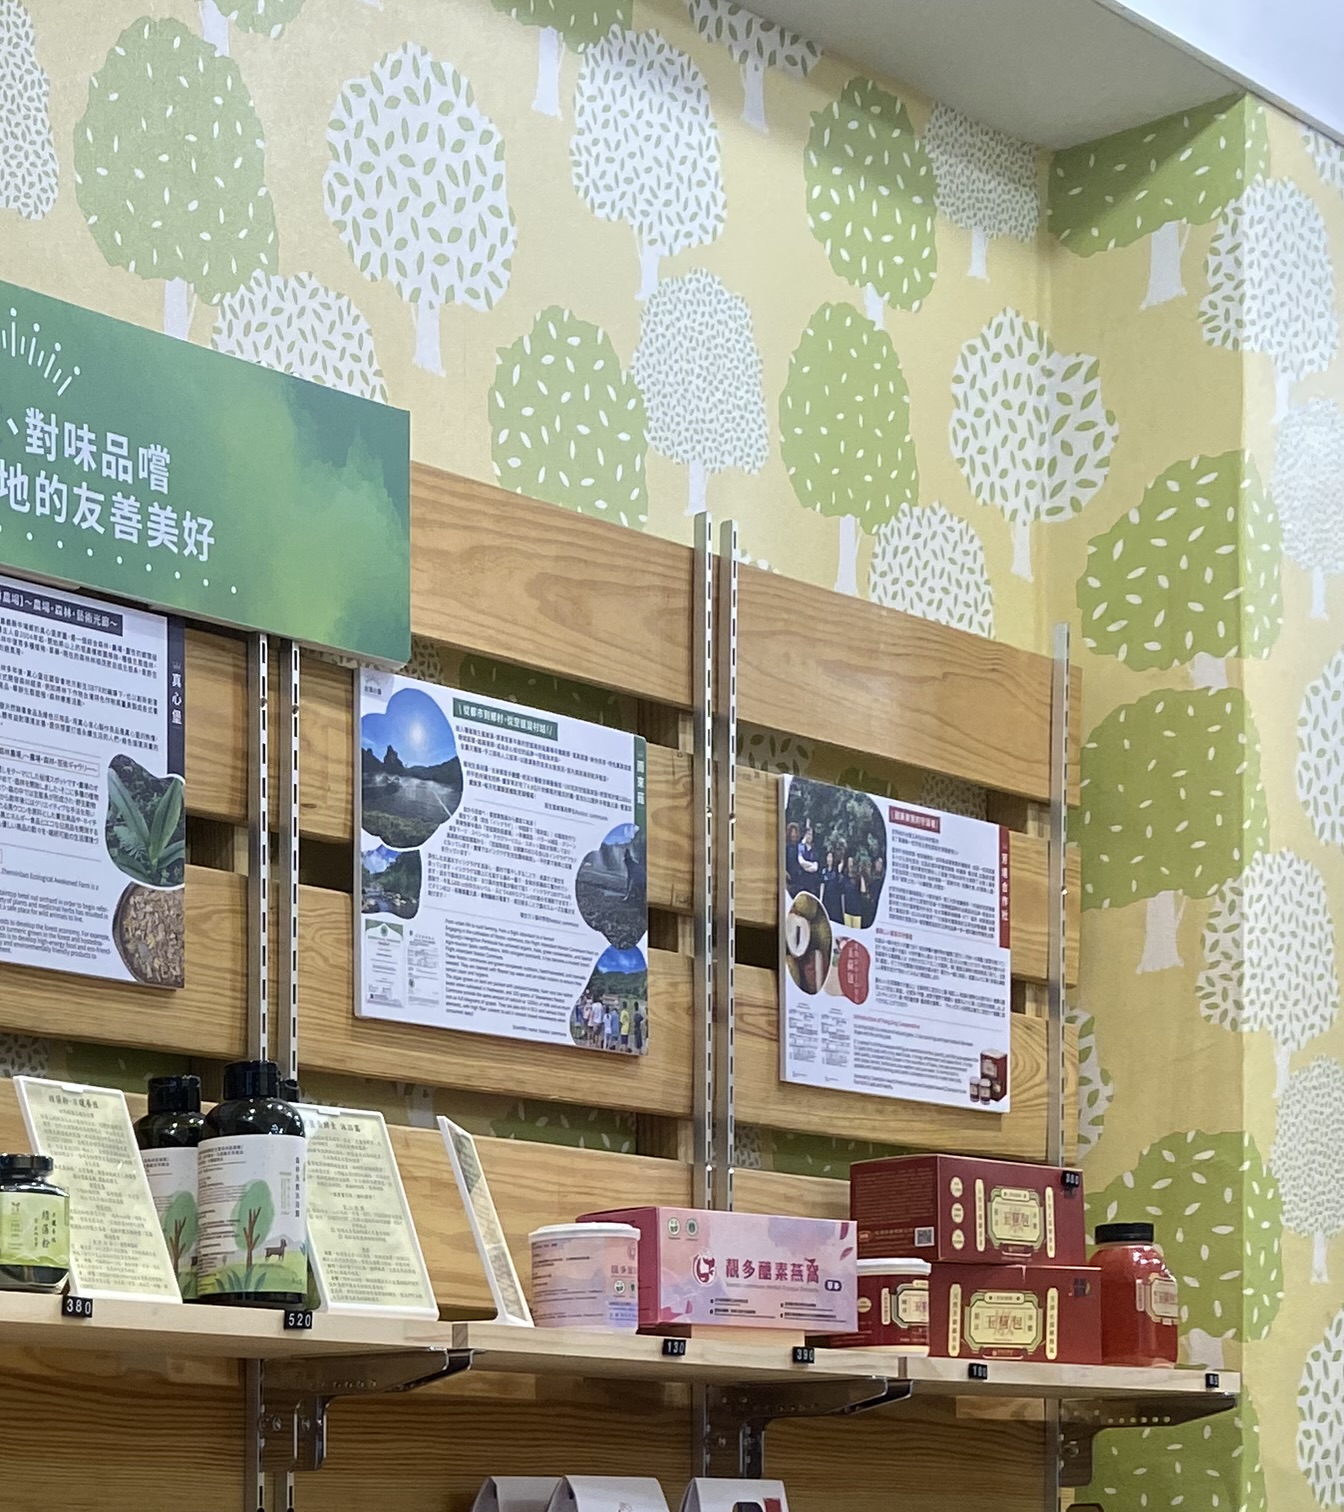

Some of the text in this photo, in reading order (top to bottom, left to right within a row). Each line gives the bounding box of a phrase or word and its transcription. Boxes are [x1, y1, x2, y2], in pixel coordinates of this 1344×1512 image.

[66, 1300, 92, 1314] 380
[288, 1313, 311, 1327] 520
[667, 1341, 685, 1355] 130
